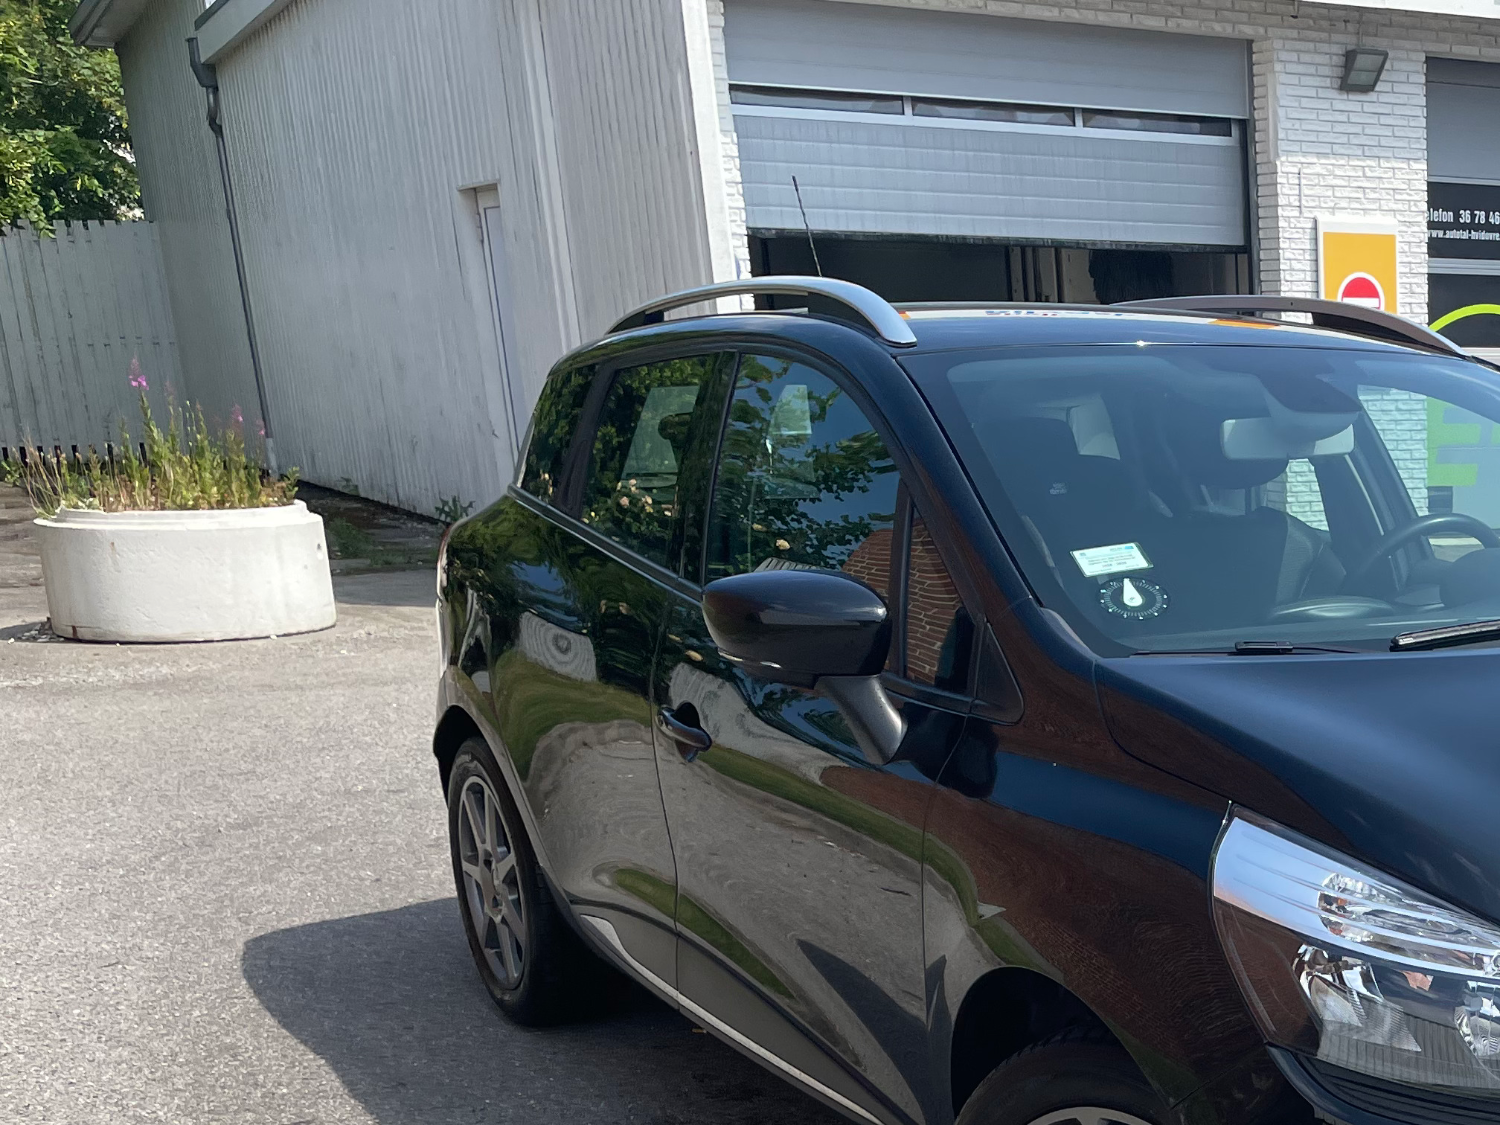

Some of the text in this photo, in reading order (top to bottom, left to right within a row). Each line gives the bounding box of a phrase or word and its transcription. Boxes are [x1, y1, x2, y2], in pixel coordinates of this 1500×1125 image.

[1426, 208, 1454, 222] elefon
[1459, 210, 1471, 223] 36
[1474, 211, 1486, 224] 78
[1488, 211, 1500, 225] 46
